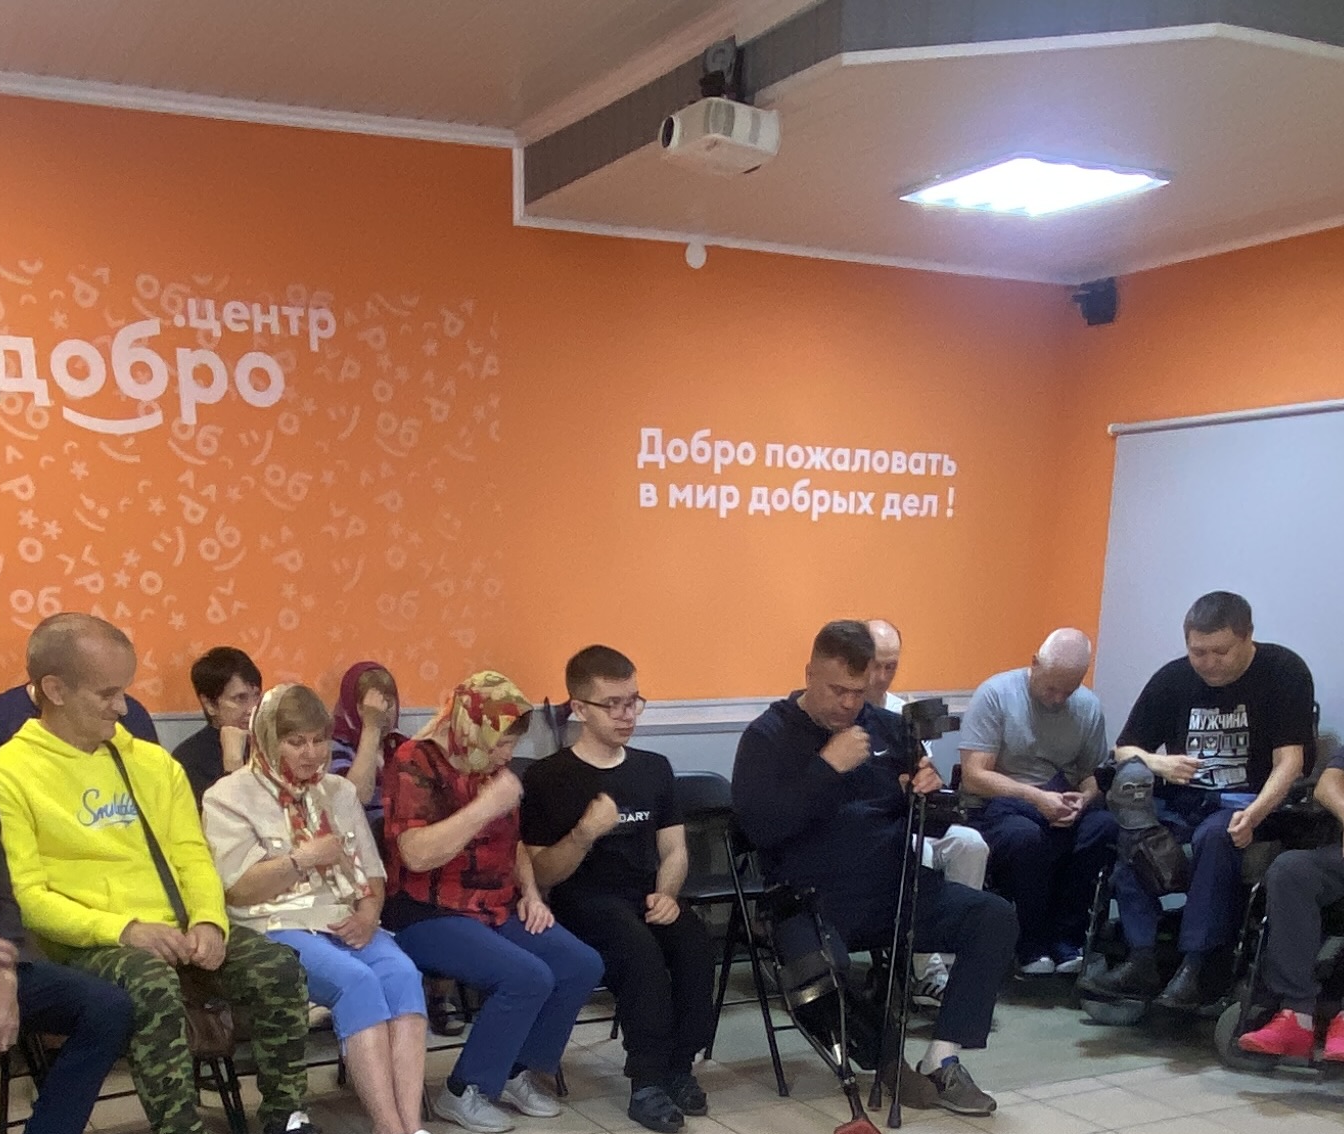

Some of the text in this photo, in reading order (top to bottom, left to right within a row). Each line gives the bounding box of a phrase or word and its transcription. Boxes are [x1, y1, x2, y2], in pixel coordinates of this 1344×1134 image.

[637, 427, 958, 478] Добро пожаловать
[639, 482, 659, 508] в
[668, 484, 740, 519] мир
[748, 478, 875, 522] добрых
[881, 494, 939, 521] дел
[1188, 711, 1249, 731] МУЖЧИНА
[617, 811, 650, 823] DARY
